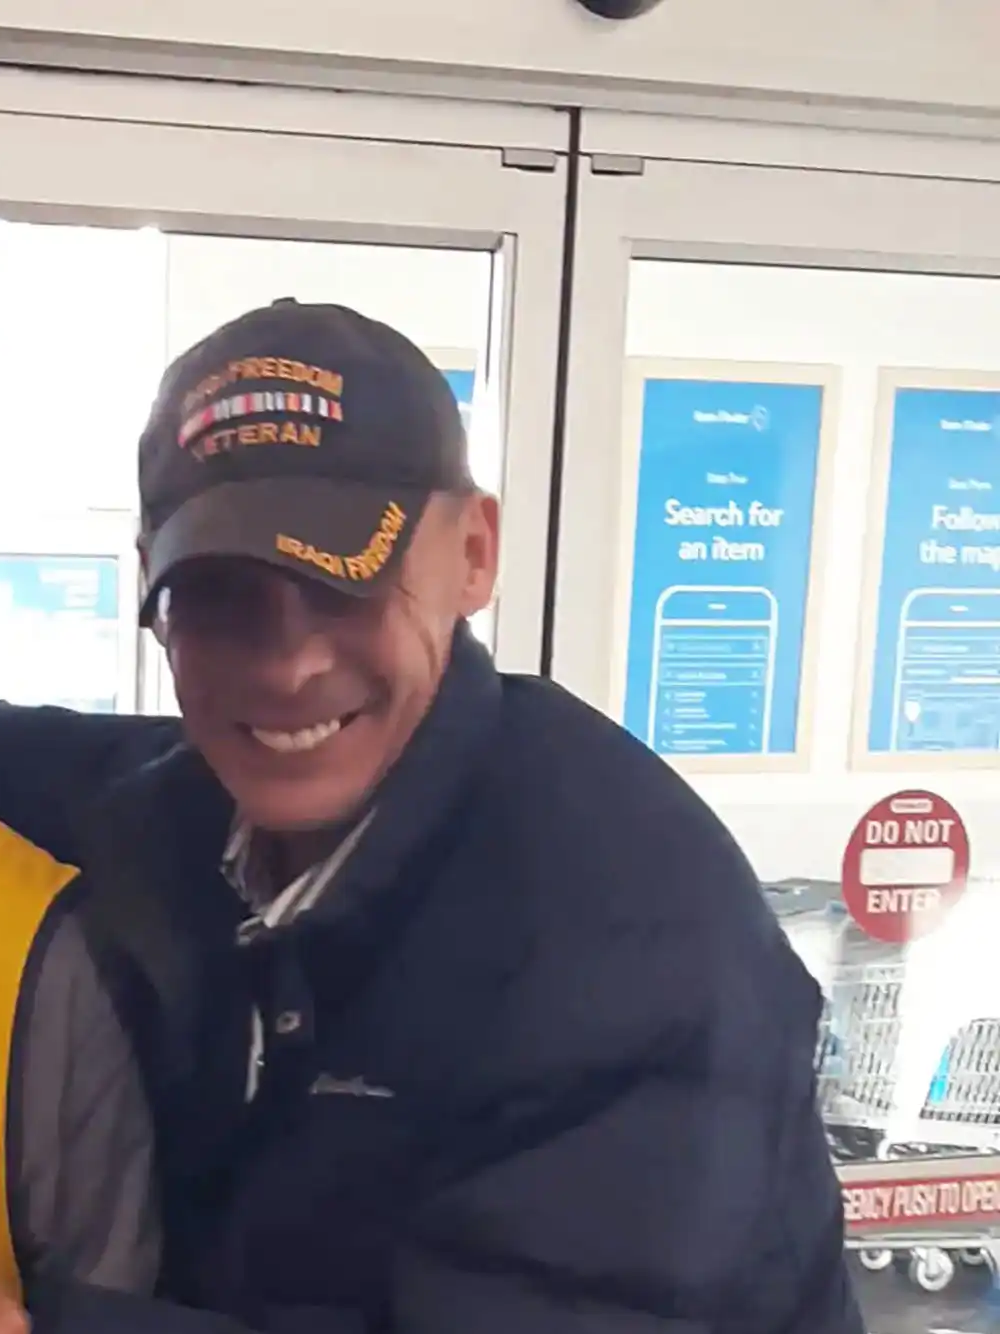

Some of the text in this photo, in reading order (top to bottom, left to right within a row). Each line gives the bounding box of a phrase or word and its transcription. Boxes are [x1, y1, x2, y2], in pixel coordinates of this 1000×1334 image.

[664, 499, 784, 528] Search for
[679, 536, 765, 561] an item
[919, 540, 957, 564] the
[866, 818, 955, 845] DO NOT
[866, 888, 941, 914] ENTER
[891, 1182, 937, 1217] PUSH
[939, 1181, 960, 1214] TO
